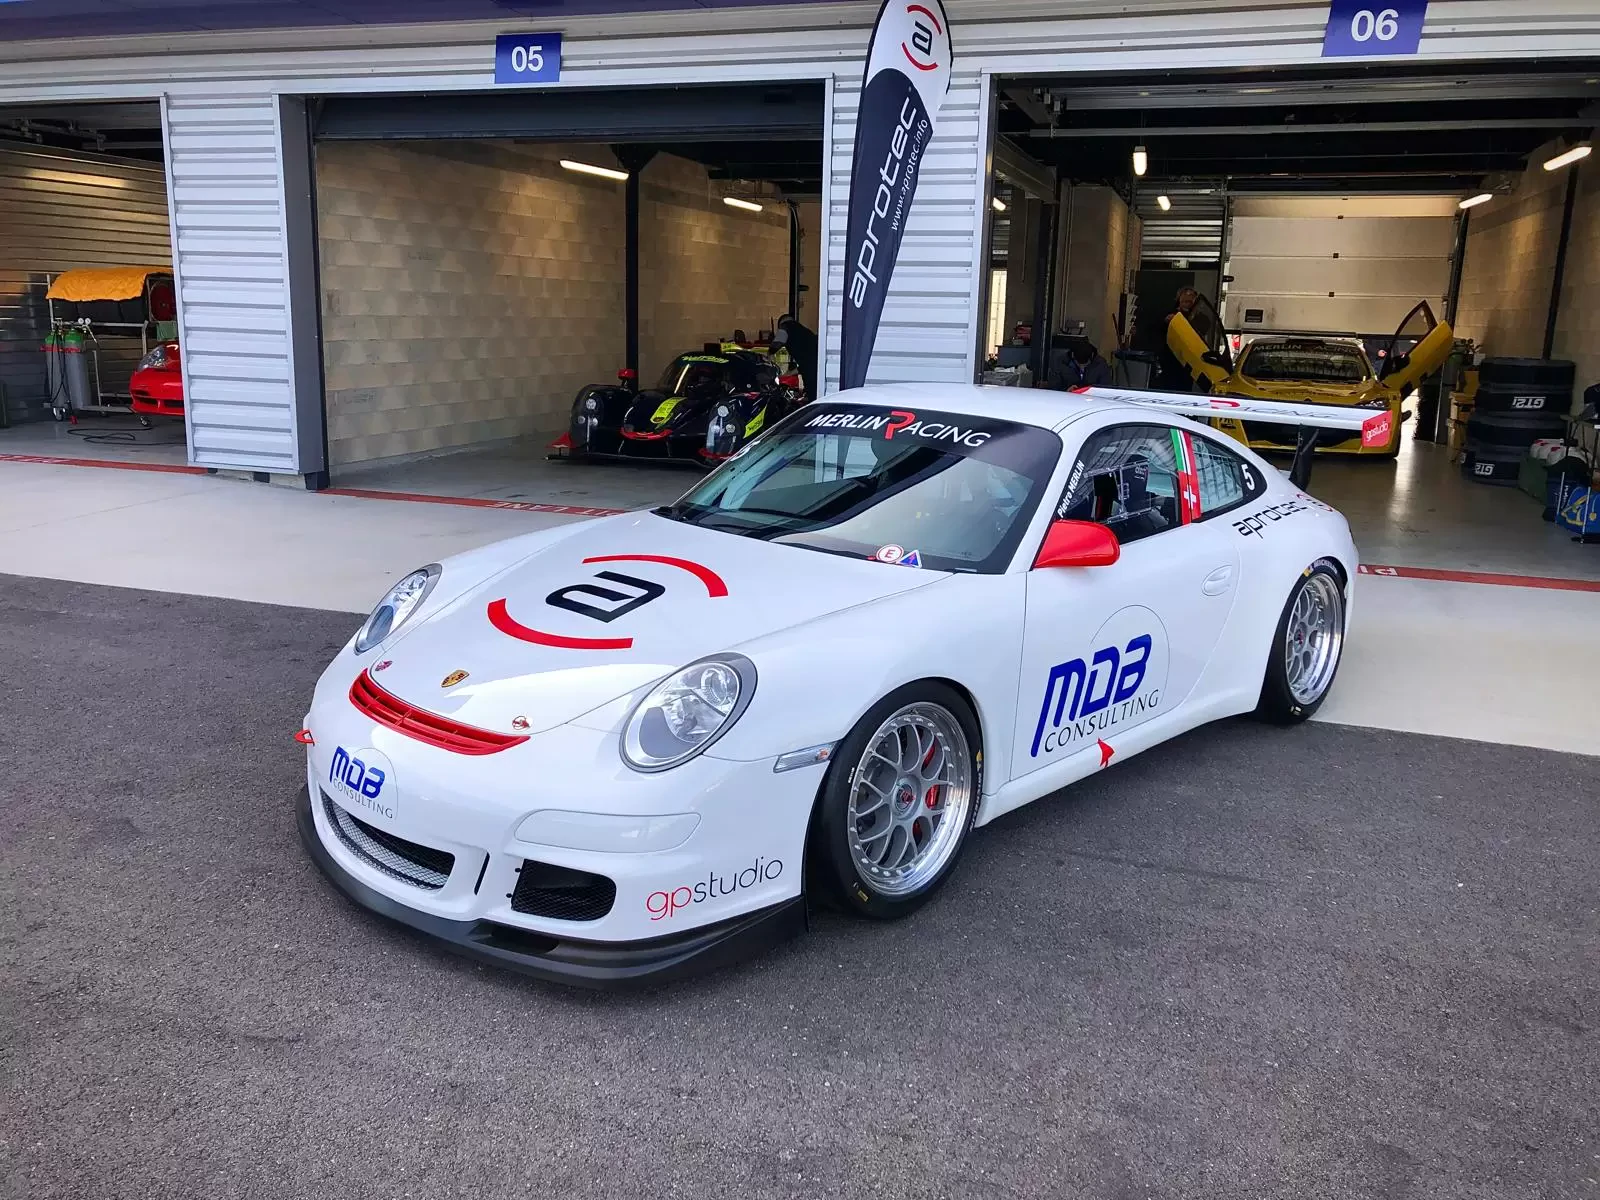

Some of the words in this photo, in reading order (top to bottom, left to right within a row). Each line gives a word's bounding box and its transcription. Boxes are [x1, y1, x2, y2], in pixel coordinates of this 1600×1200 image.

[1351, 9, 1399, 42] 06
[511, 45, 544, 72] 05
[849, 97, 917, 308] aprotec
[891, 118, 928, 231] www.aprotec.info
[1057, 491, 1073, 518] Pietro
[1068, 460, 1085, 493] MERLIN
[1241, 464, 1255, 490] 5
[1232, 501, 1307, 539] aprotec
[1031, 633, 1152, 757] MDB
[1044, 689, 1159, 752] CONSULTING
[329, 745, 386, 799] MDB
[333, 778, 393, 819] CONSULTING
[646, 856, 783, 921] gpstudio
